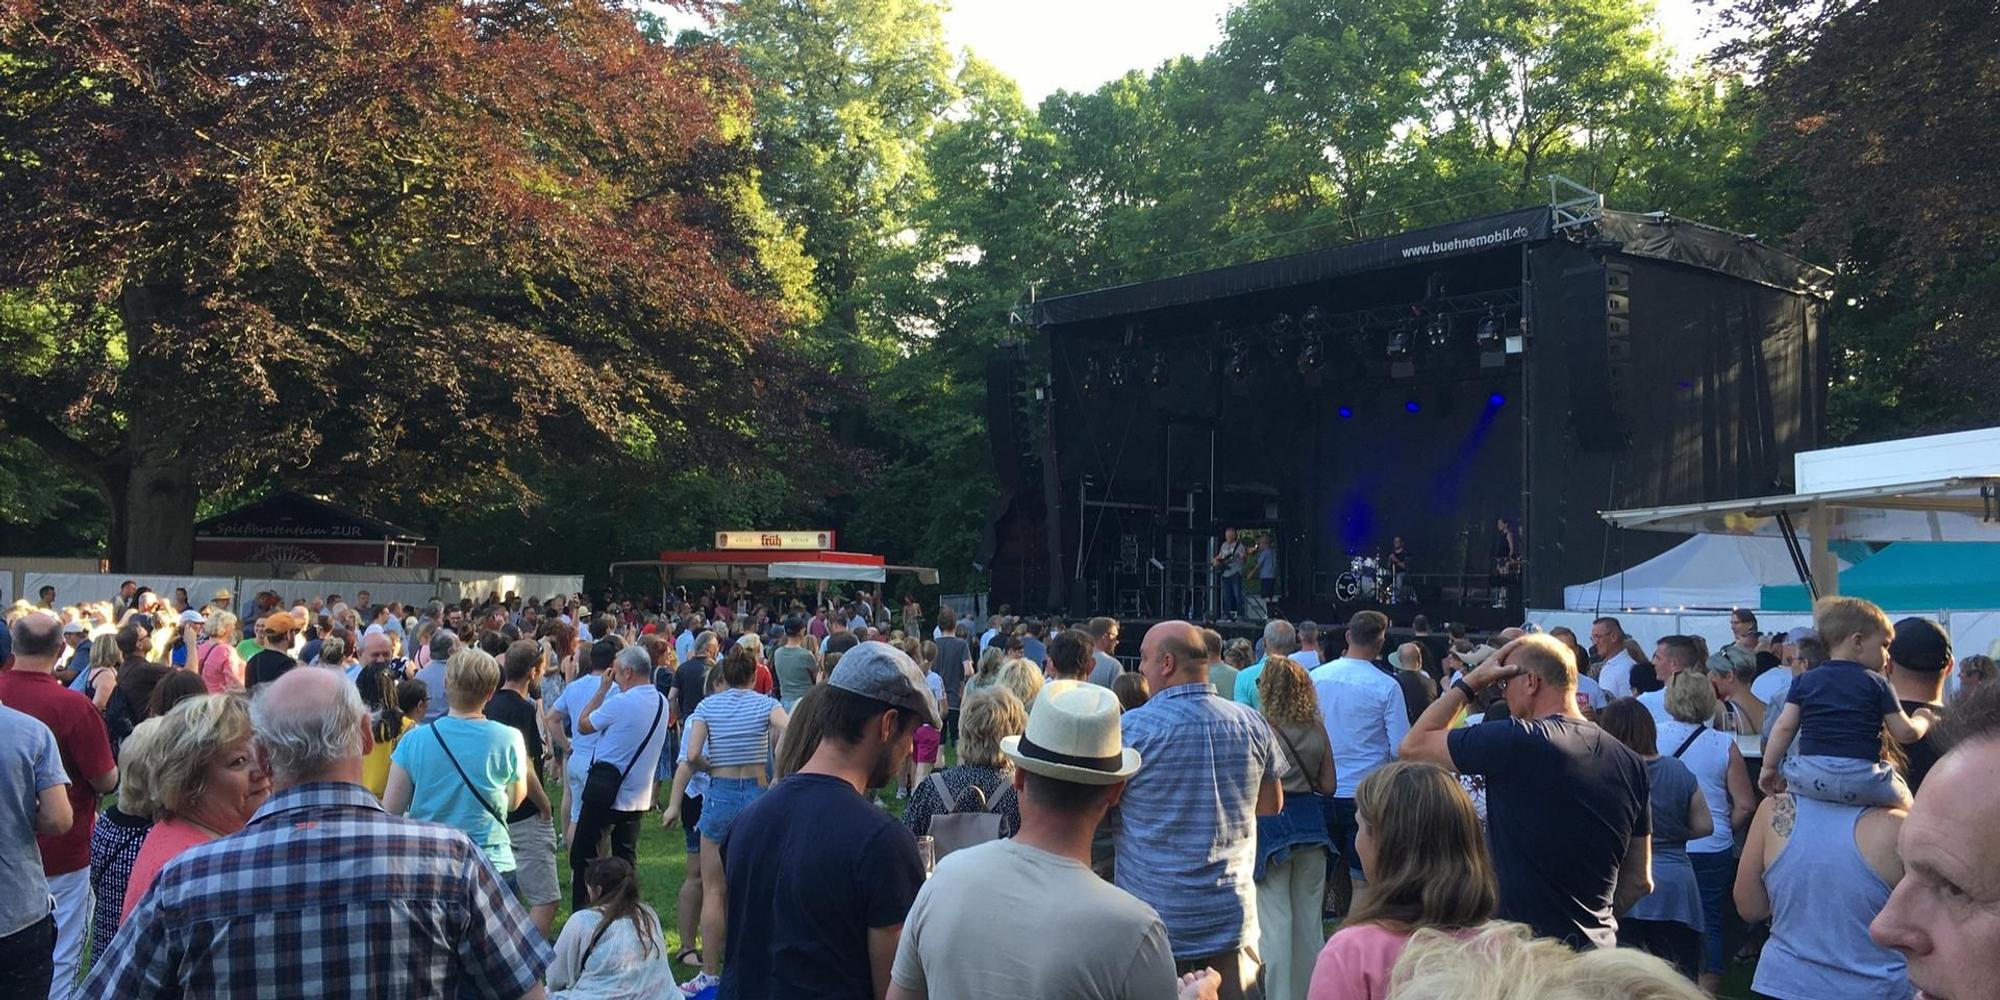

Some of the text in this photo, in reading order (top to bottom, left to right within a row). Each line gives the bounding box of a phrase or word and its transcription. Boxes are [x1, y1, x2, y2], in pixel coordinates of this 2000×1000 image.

[1402, 226, 1528, 258] www.buehnemobil.de
[331, 526, 361, 537] ZUR
[761, 534, 782, 547] früh
